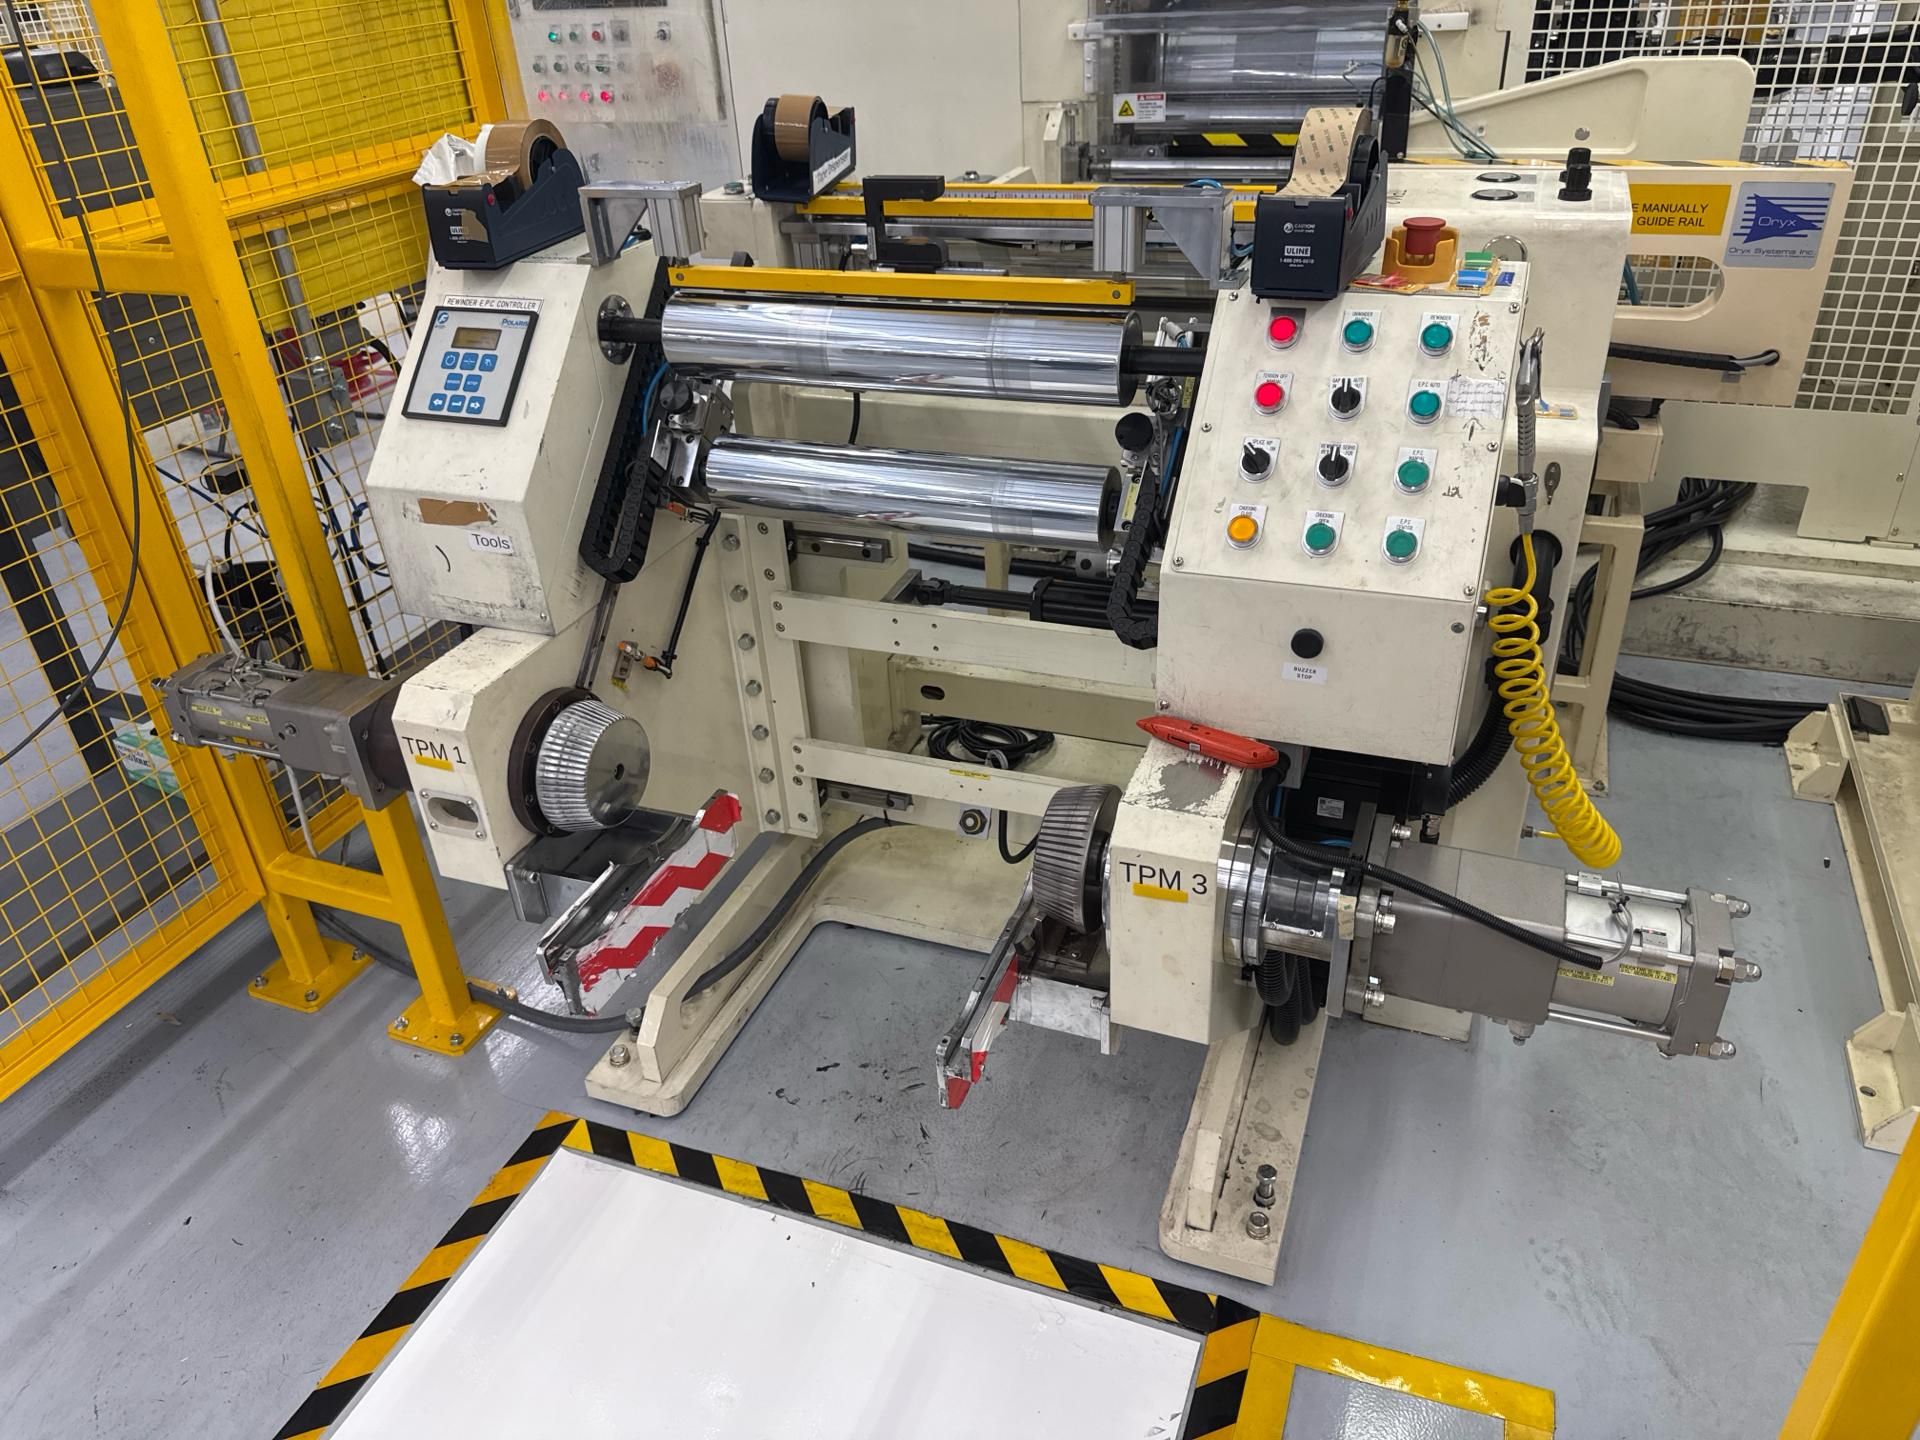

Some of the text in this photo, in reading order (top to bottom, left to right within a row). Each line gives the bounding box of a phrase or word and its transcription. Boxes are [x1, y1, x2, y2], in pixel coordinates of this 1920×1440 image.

[1642, 203, 1708, 213] MANUALLY
[1637, 216, 1705, 227] GUIDE RAIL
[1758, 216, 1797, 226] Oryx
[1286, 247, 1310, 255] ULINE
[1728, 247, 1750, 255] Oryx
[447, 298, 477, 306] REWINDER
[496, 300, 537, 309] CONTROLLER
[472, 533, 510, 549] Tools
[1294, 666, 1316, 674] BUZZER
[401, 736, 467, 764] TPM 1
[1119, 862, 1207, 894] TPM 3
